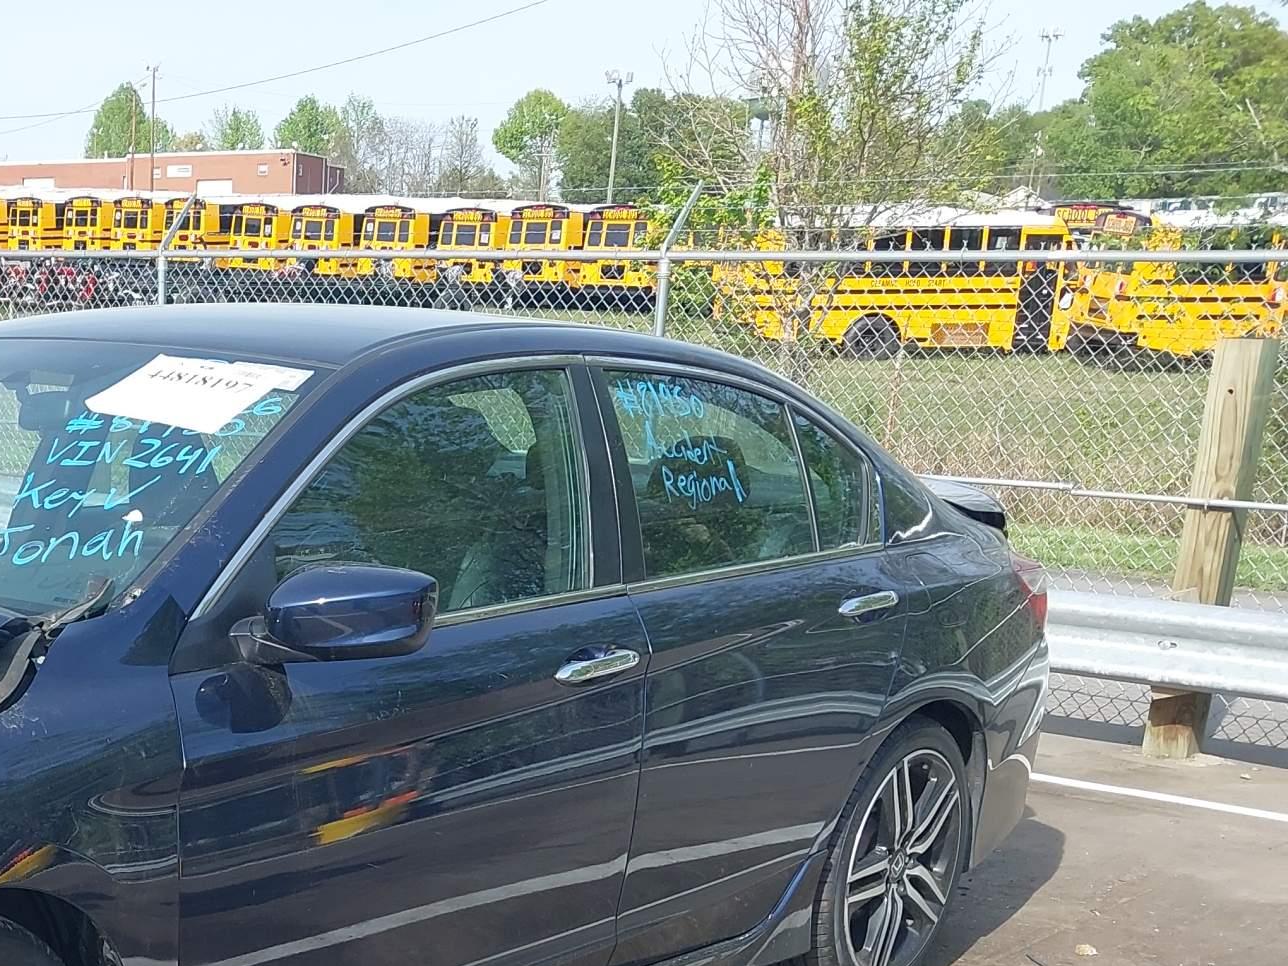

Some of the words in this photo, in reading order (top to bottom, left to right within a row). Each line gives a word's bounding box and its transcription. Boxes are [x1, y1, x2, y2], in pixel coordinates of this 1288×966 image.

[148, 368, 254, 392] 44818197
[46, 437, 128, 466] VIN
[123, 438, 222, 475] 2641
[12, 471, 97, 518] Key
[661, 459, 748, 511] Regional
